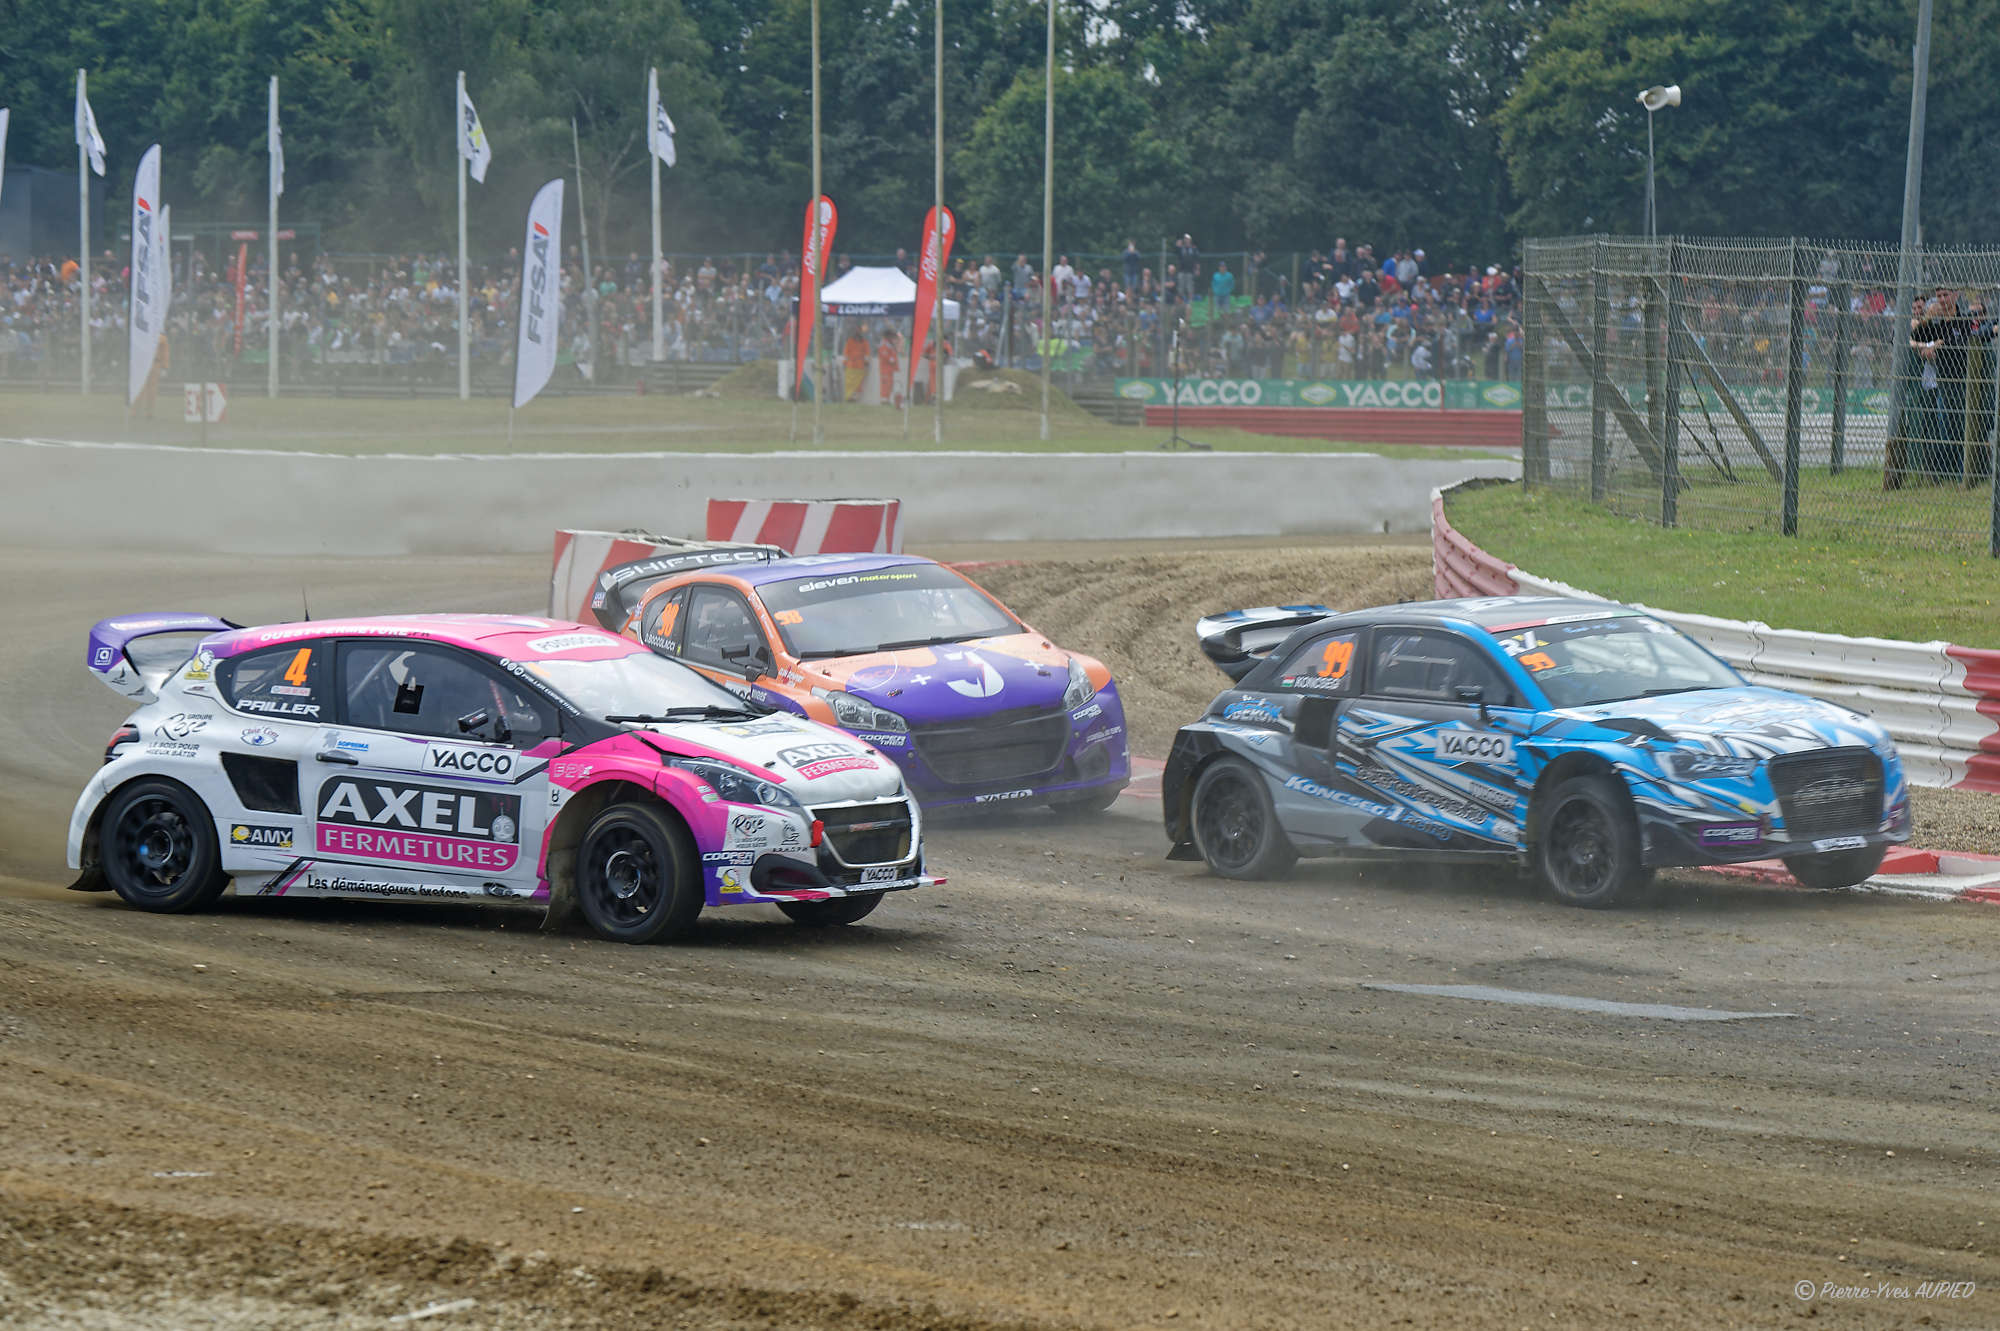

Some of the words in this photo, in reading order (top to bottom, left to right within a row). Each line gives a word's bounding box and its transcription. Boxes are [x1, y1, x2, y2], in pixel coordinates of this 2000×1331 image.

[134, 213, 151, 333] FFSA
[527, 236, 551, 344] FFSA
[1160, 380, 1262, 405] YACCO
[1342, 382, 1442, 407] YACCO
[799, 575, 860, 592] eleven
[657, 602, 680, 636] 98
[774, 609, 803, 626] 98
[284, 648, 312, 686] 4
[1318, 641, 1354, 678] 99
[234, 699, 321, 718] PAILLER
[1442, 735, 1505, 758] YACCO
[432, 749, 512, 775] YACCO
[319, 782, 490, 836] AXEL
[251, 829, 292, 844] AMY
[325, 829, 509, 867] FERMETURES
[702, 852, 754, 861] COOPER
[307, 875, 328, 890] Les
[331, 877, 416, 897] déménageurs
